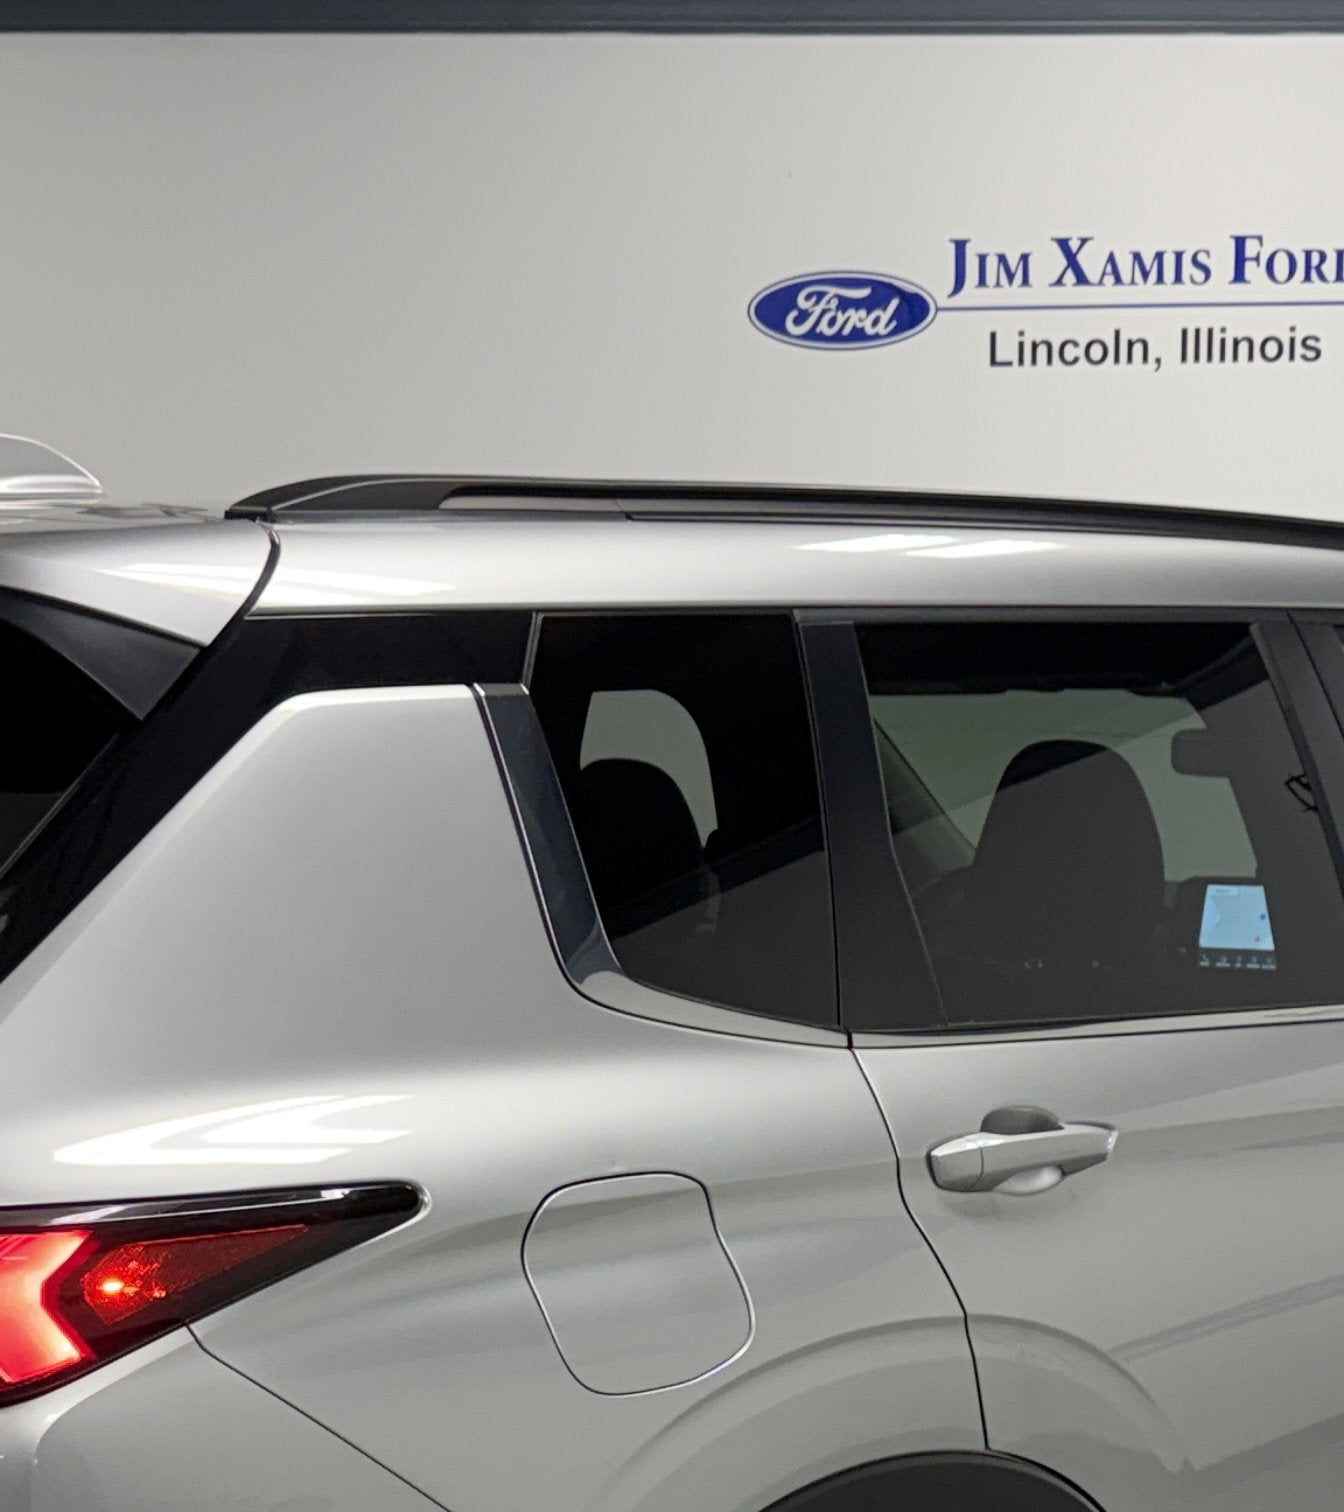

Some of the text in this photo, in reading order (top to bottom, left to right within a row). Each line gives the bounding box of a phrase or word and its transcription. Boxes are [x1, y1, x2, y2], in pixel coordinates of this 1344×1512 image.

[947, 238, 1031, 299] JIM
[1049, 236, 1212, 287] XAMIS
[989, 326, 1322, 372] Lincoln, Illinois
